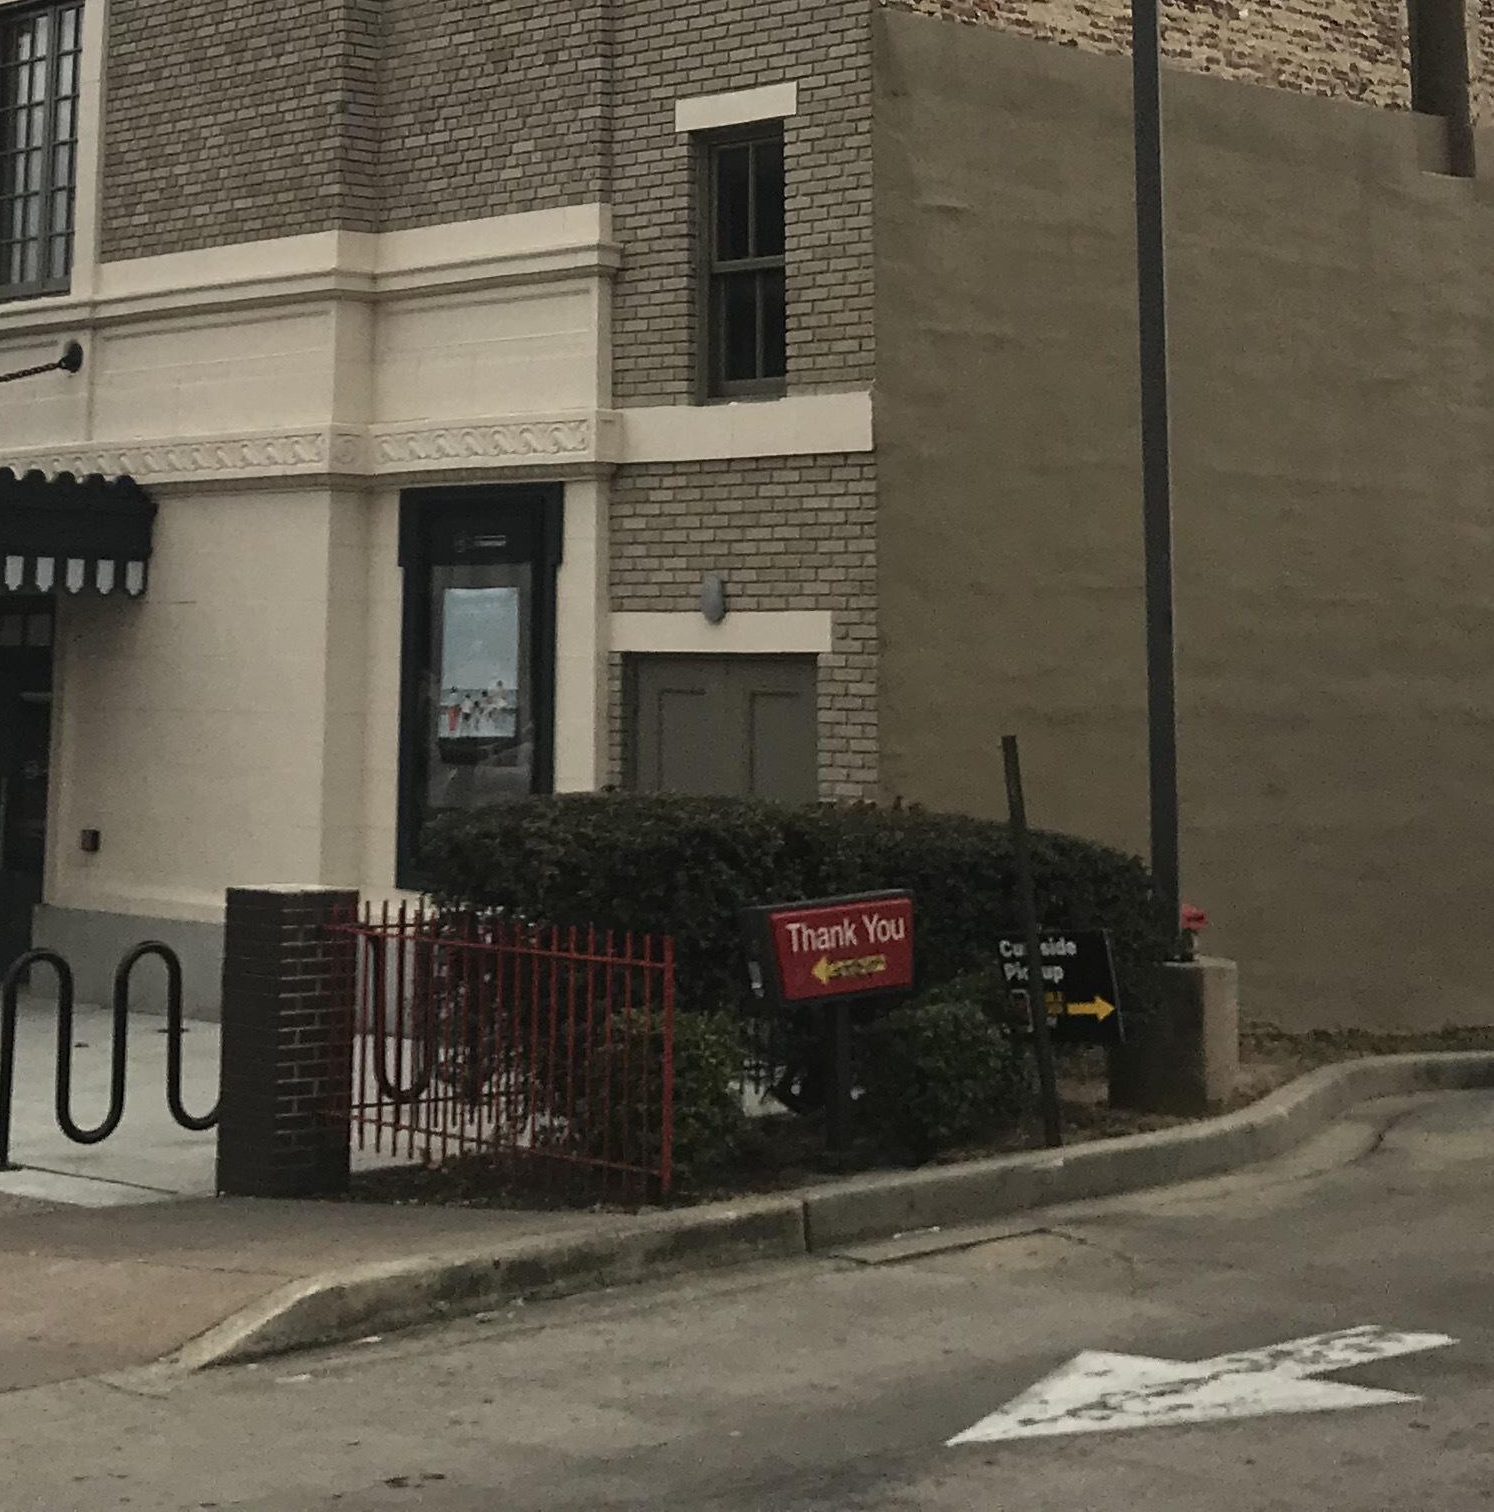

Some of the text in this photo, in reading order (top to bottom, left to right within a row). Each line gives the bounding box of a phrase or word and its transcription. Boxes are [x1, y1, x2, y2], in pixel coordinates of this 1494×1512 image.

[785, 913, 906, 953] Thank You
[999, 936, 1077, 958] Cuside
